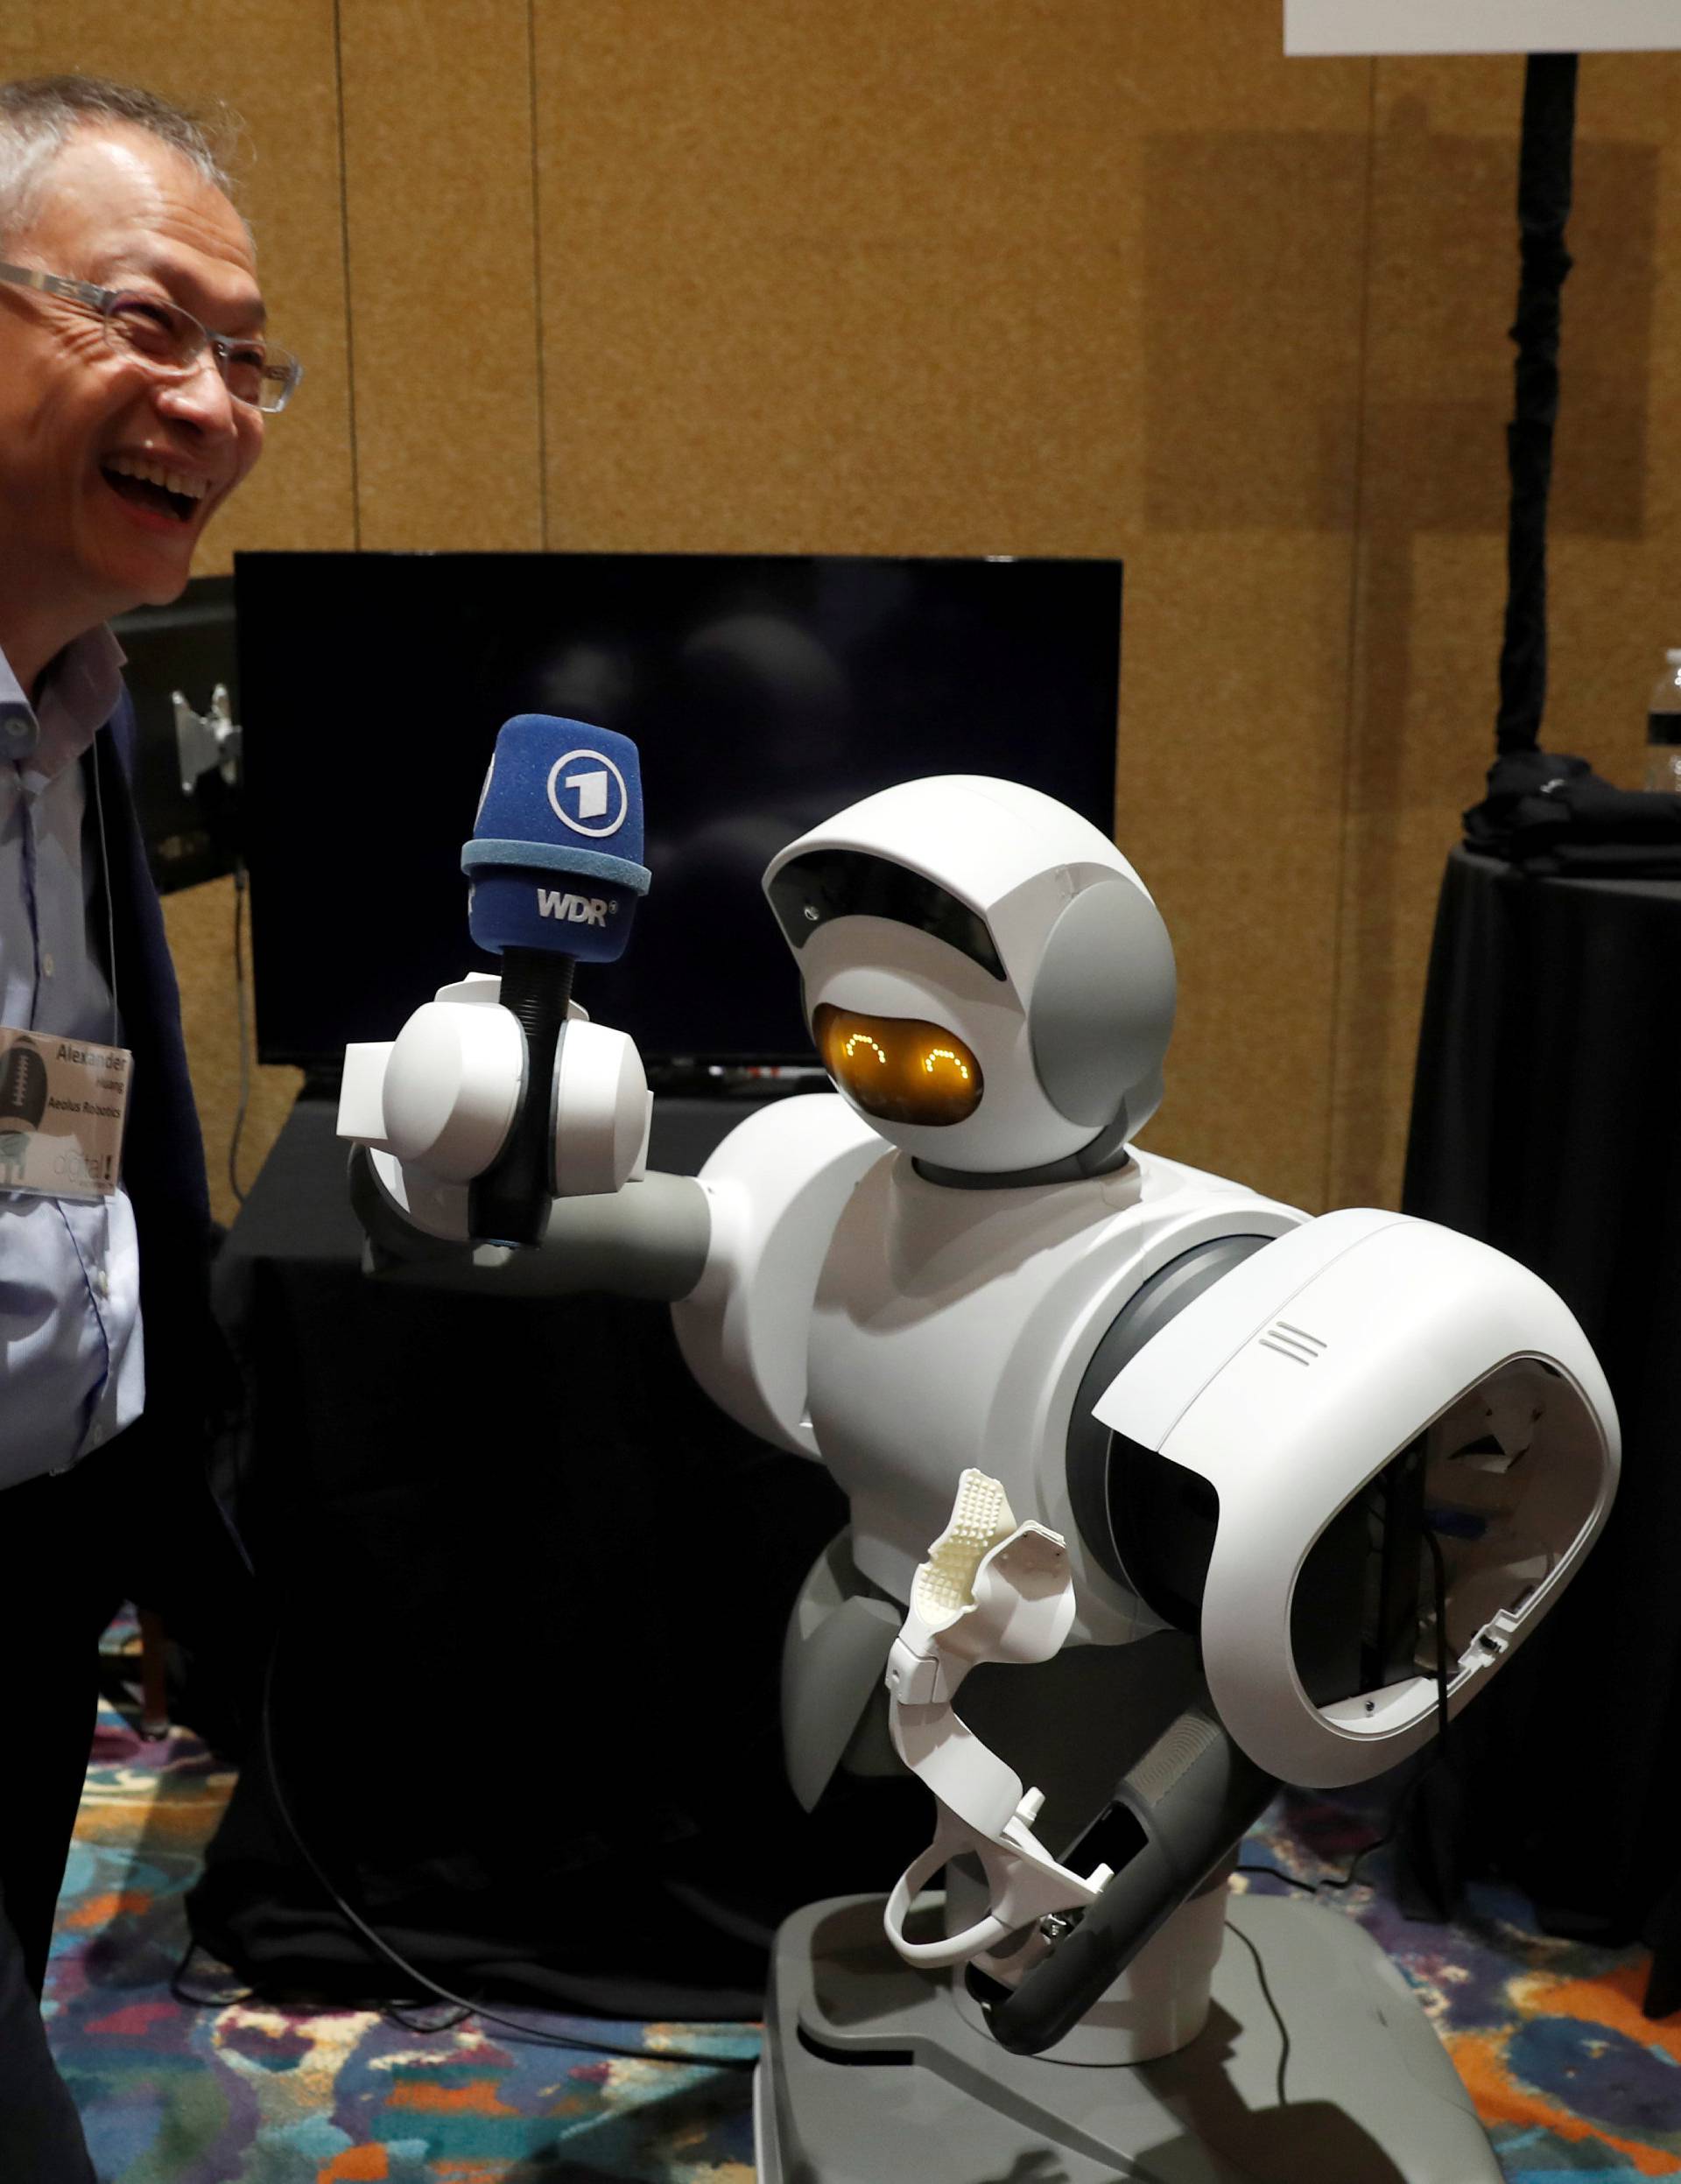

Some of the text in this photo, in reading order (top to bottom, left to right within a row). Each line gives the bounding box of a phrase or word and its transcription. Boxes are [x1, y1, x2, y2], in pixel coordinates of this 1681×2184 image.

[566, 770, 608, 819] 1
[57, 1044, 126, 1071] Alexander
[48, 1097, 121, 1119] Aeolus Robotics
